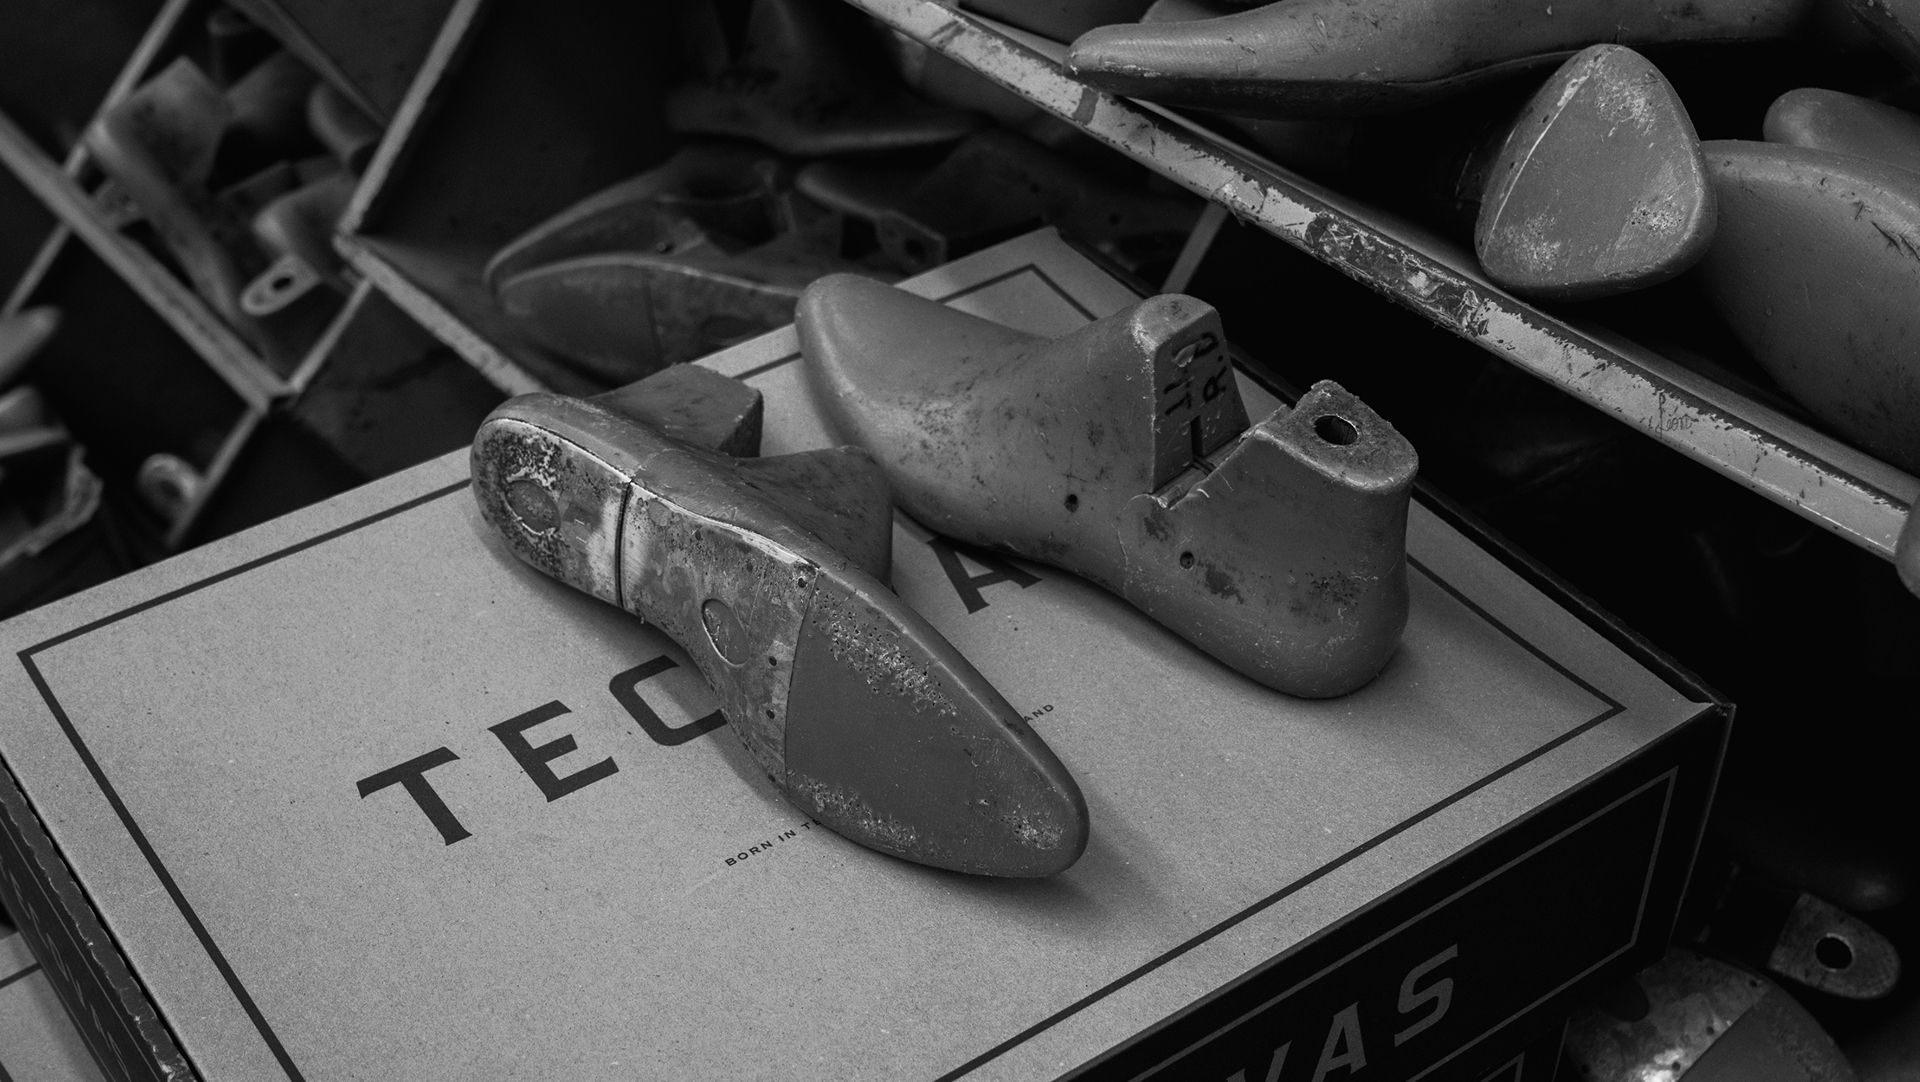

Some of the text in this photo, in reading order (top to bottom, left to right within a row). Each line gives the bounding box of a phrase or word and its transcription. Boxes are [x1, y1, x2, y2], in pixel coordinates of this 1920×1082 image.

[725, 840, 773, 867] BORN
[778, 829, 797, 842] IN
[1023, 704, 1054, 722] AND
